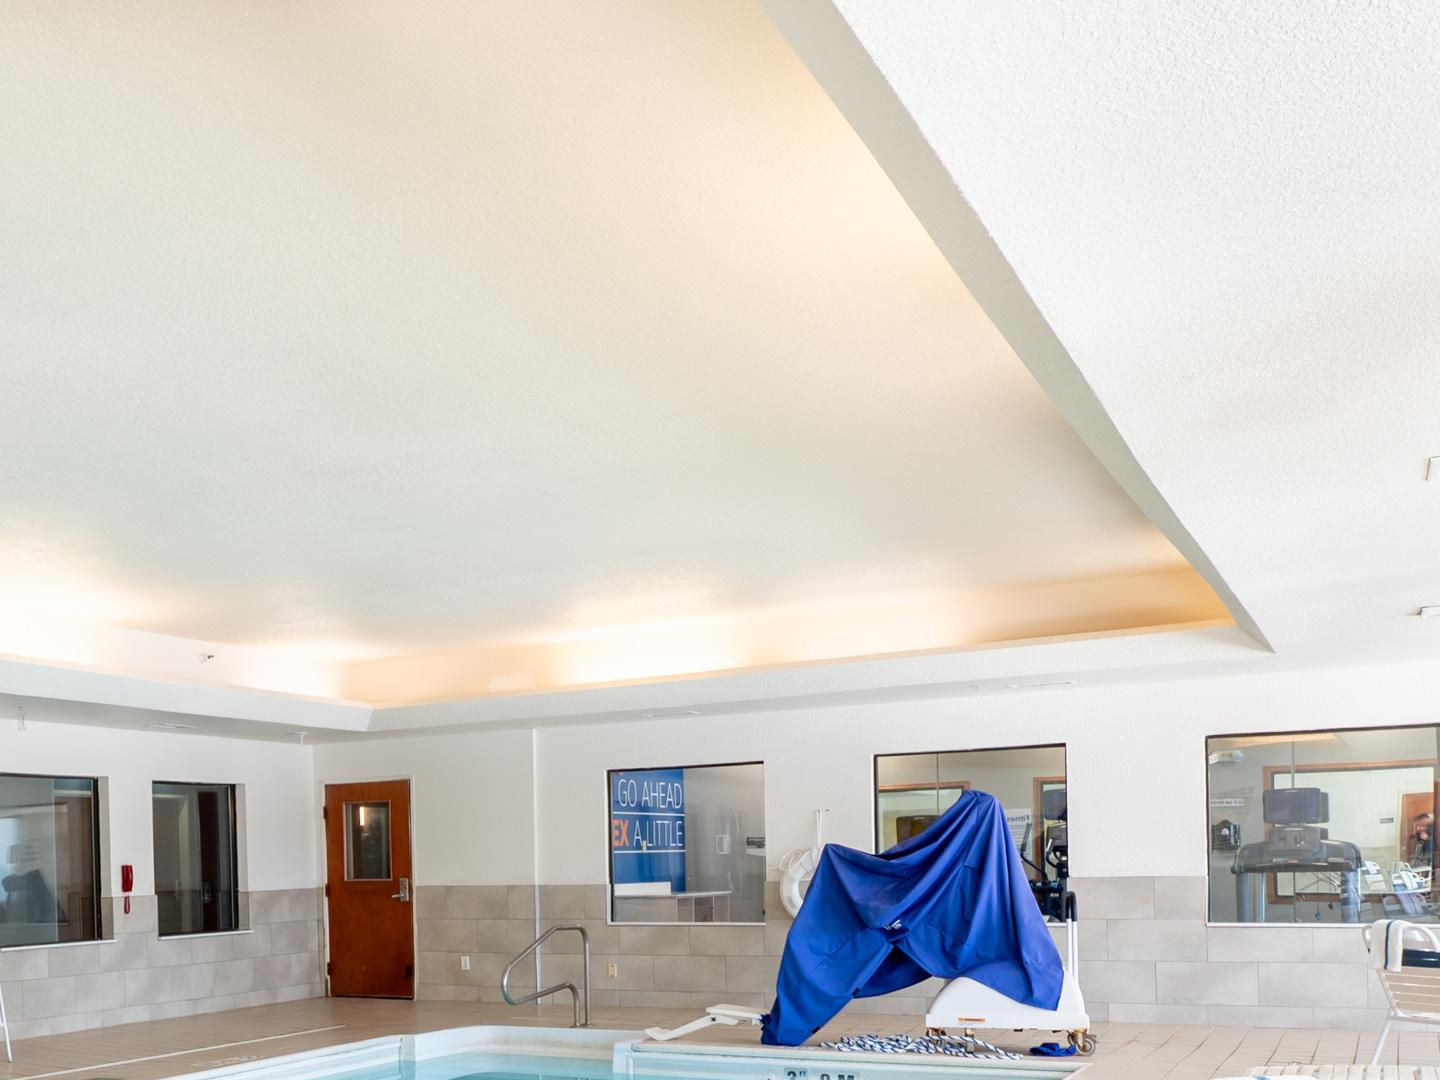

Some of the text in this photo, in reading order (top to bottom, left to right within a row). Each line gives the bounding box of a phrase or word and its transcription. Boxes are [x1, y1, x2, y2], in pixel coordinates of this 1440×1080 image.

[617, 778, 683, 809] GO AHEAD
[633, 819, 643, 847] A
[646, 819, 683, 847] LITTLE
